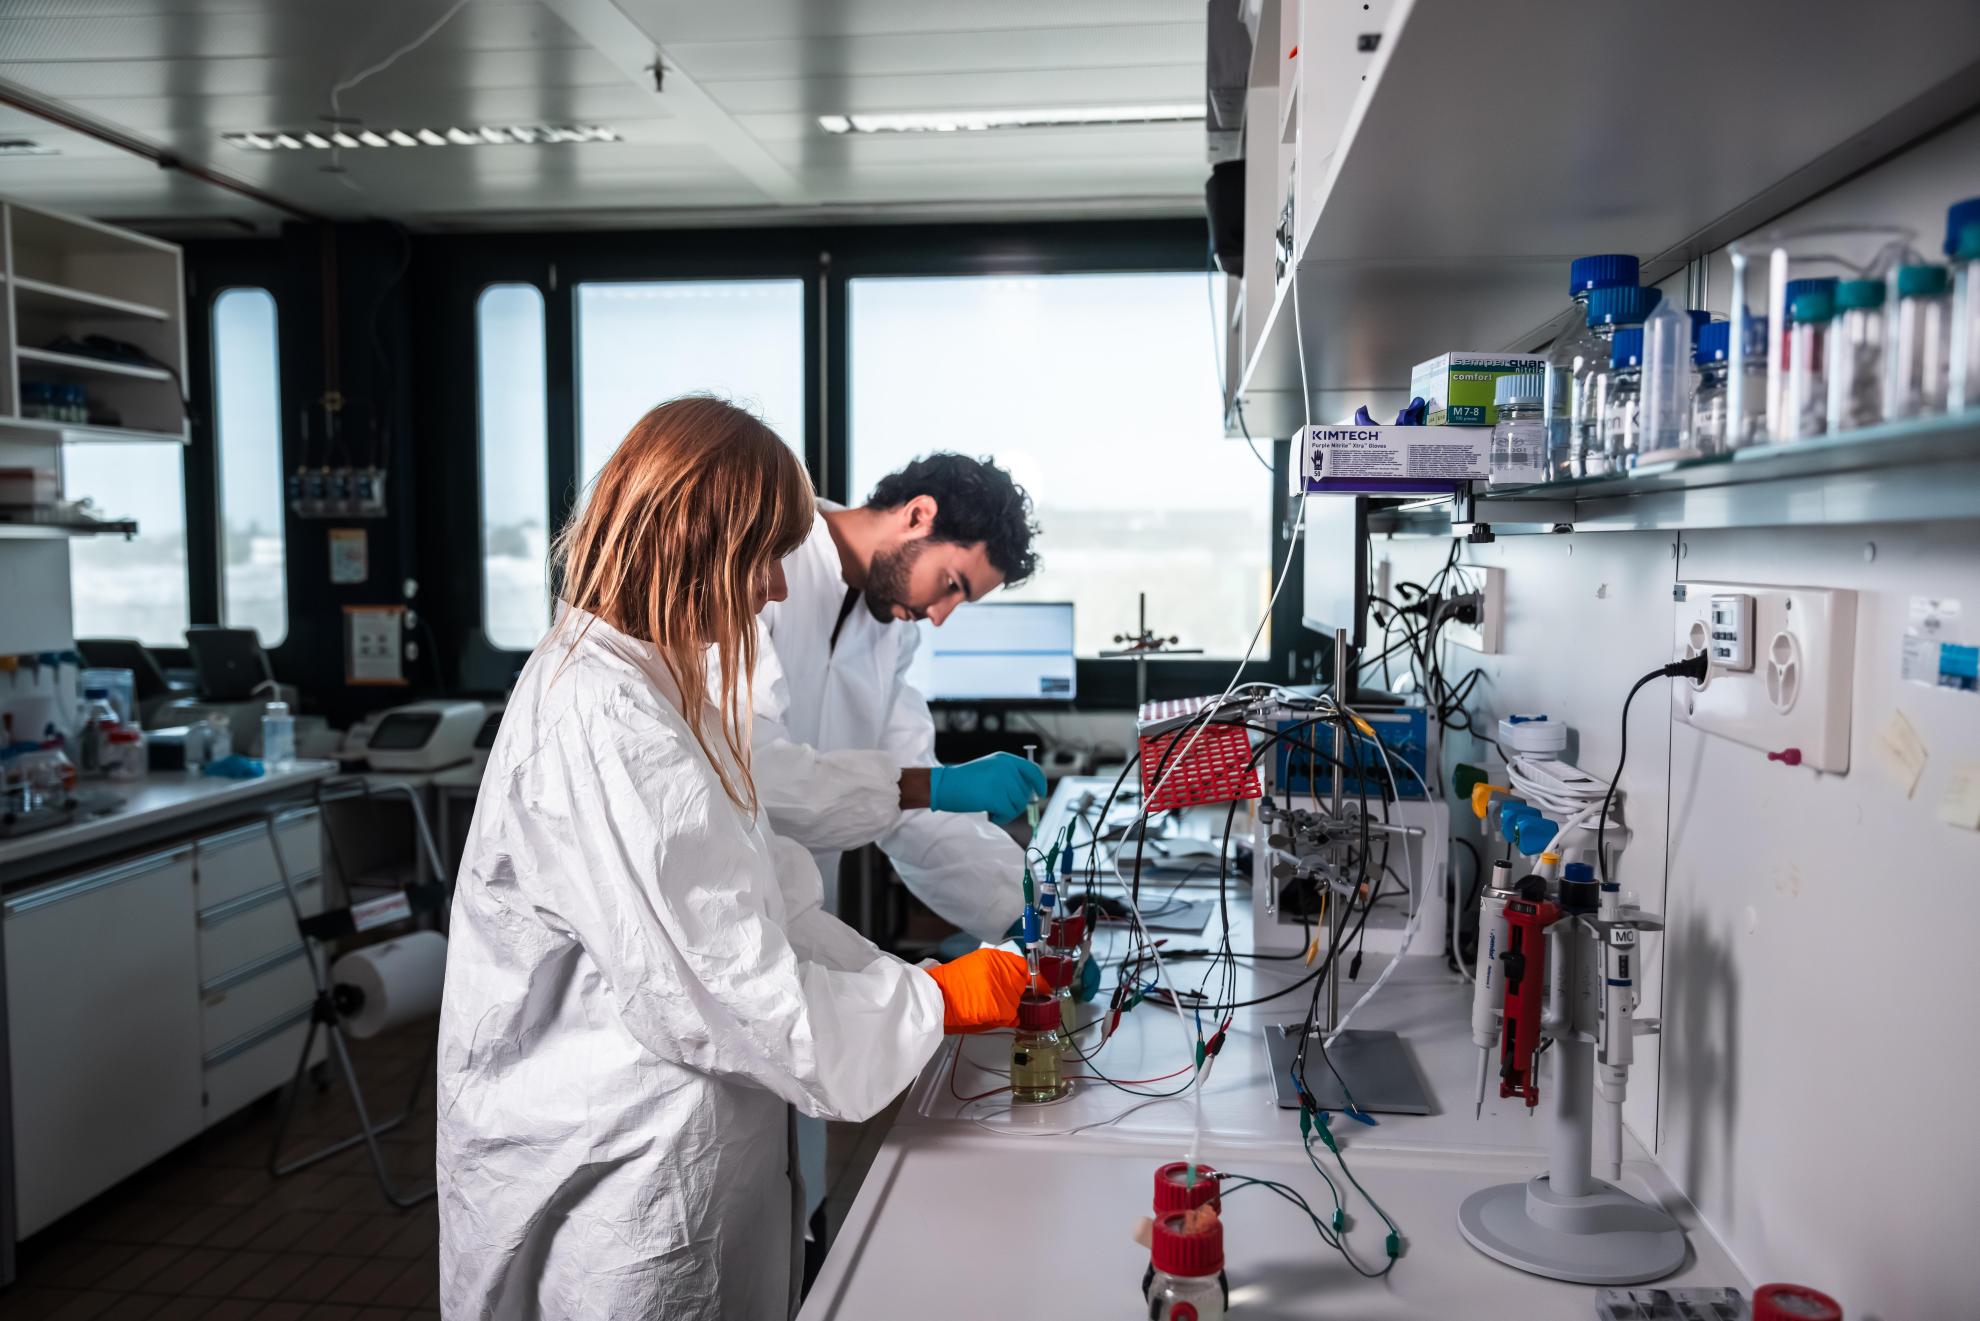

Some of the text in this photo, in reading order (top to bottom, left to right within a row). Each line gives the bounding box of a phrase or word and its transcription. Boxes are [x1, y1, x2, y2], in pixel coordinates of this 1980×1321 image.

[1453, 373, 1492, 381] comfort
[1453, 407, 1480, 417] M 7-8
[1312, 430, 1379, 441] KIMTECH
